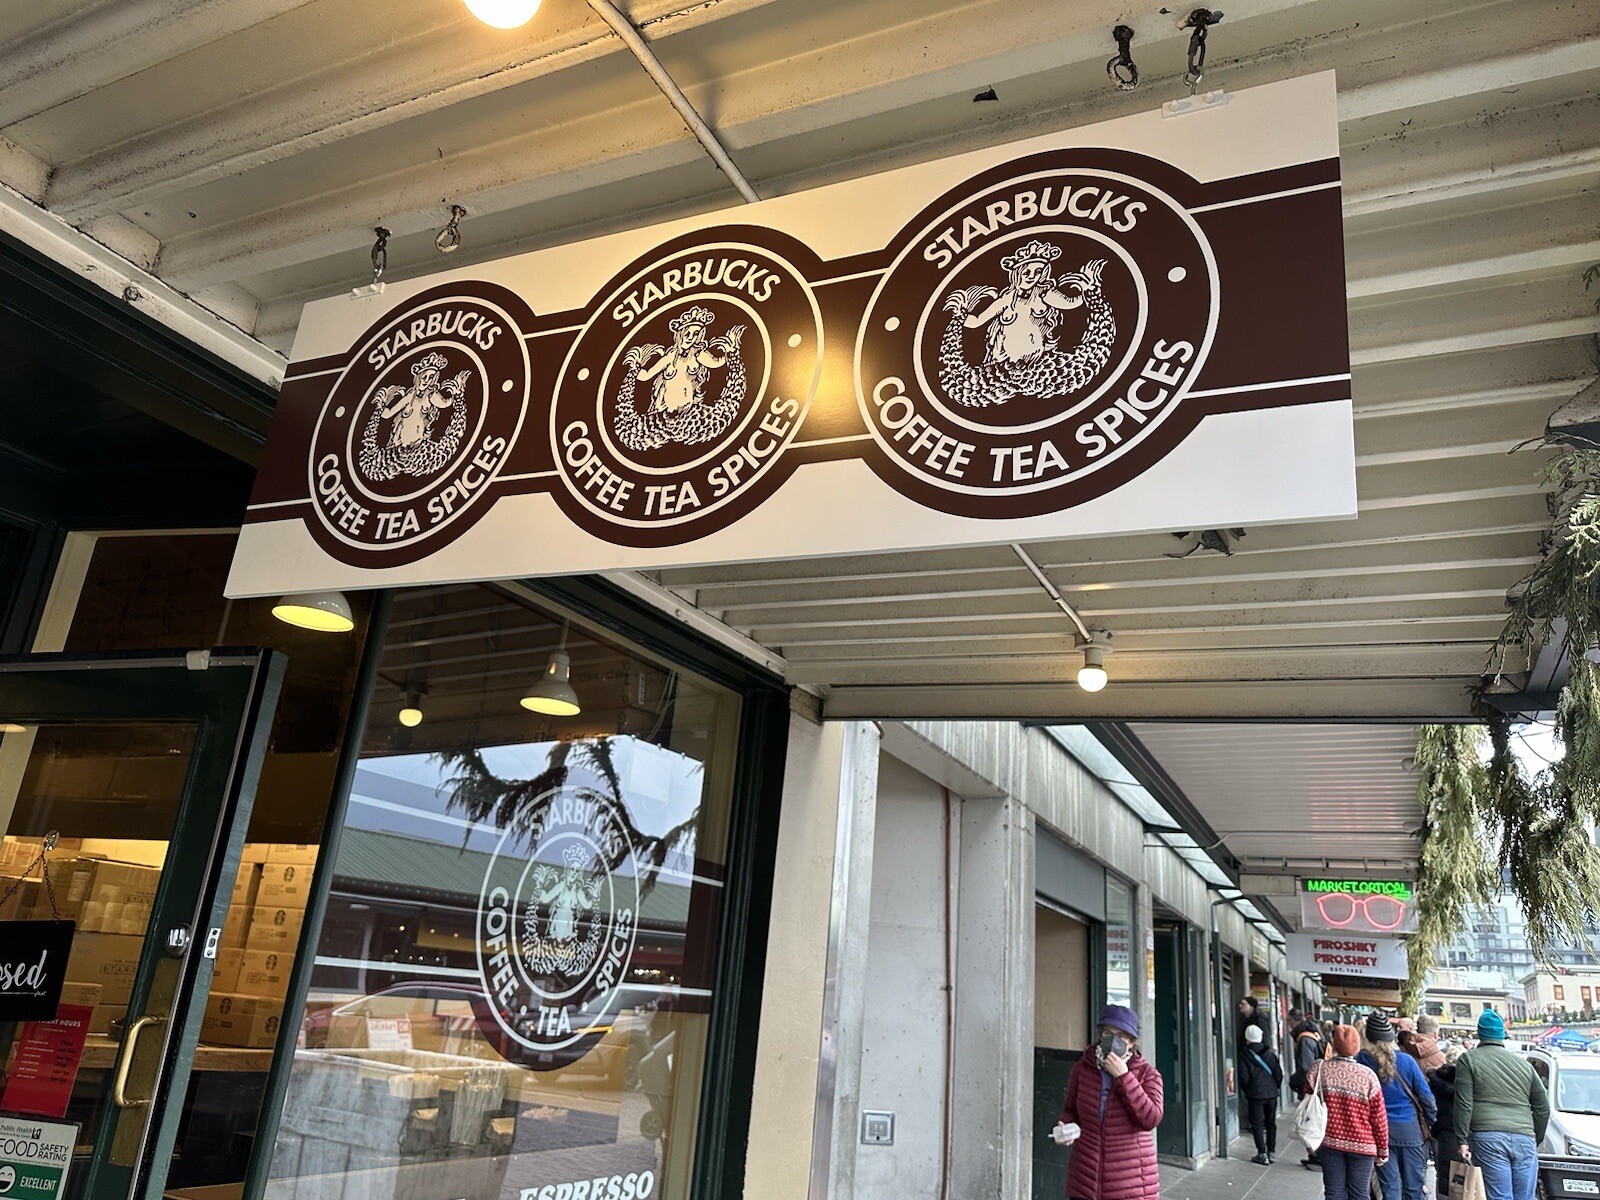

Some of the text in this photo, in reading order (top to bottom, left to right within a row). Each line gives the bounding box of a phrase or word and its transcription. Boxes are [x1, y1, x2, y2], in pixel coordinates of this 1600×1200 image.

[922, 185, 1148, 270] STARBUCKS
[612, 258, 781, 329] STARBUCKS
[367, 310, 503, 372] STARBUCKS
[871, 338, 1195, 483] COFFEE TEA SPICES
[560, 394, 800, 517] COFFEE TEA SPICES
[315, 434, 507, 541] COFFEE TEA SPICES
[529, 798, 623, 859] STARBUCKS
[1307, 880, 1355, 893] MARKET
[487, 885, 632, 1037] COFFEE TEA SPICES
[1313, 939, 1377, 952] PIROSHKY
[1313, 952, 1378, 967] PIROSHKY
[37, 1151, 67, 1161] RATING
[40, 1143, 69, 1153] SAFETY
[20, 1176, 57, 1191] EXCELLENT
